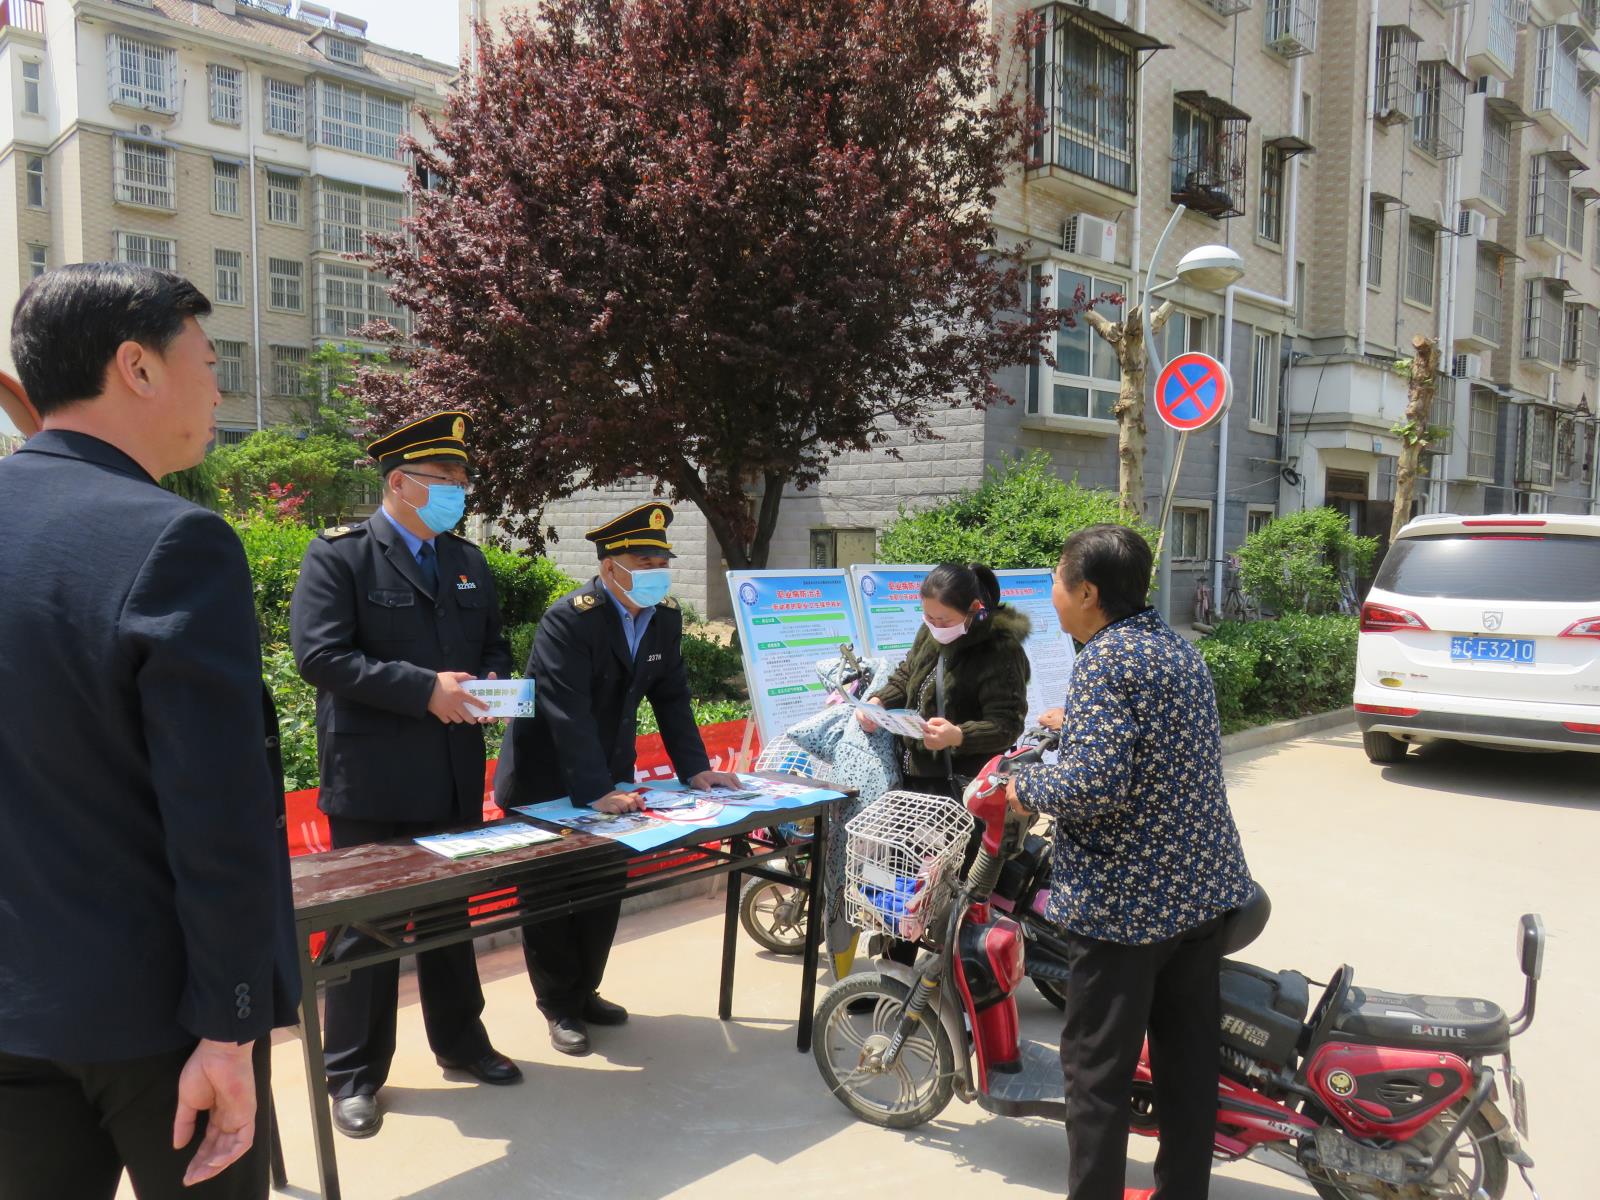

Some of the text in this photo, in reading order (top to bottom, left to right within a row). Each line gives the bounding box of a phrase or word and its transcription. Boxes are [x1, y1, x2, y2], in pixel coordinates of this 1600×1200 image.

[777, 589, 822, 600] 职业病防治法
[1411, 1024, 1468, 1039] BATTLE
